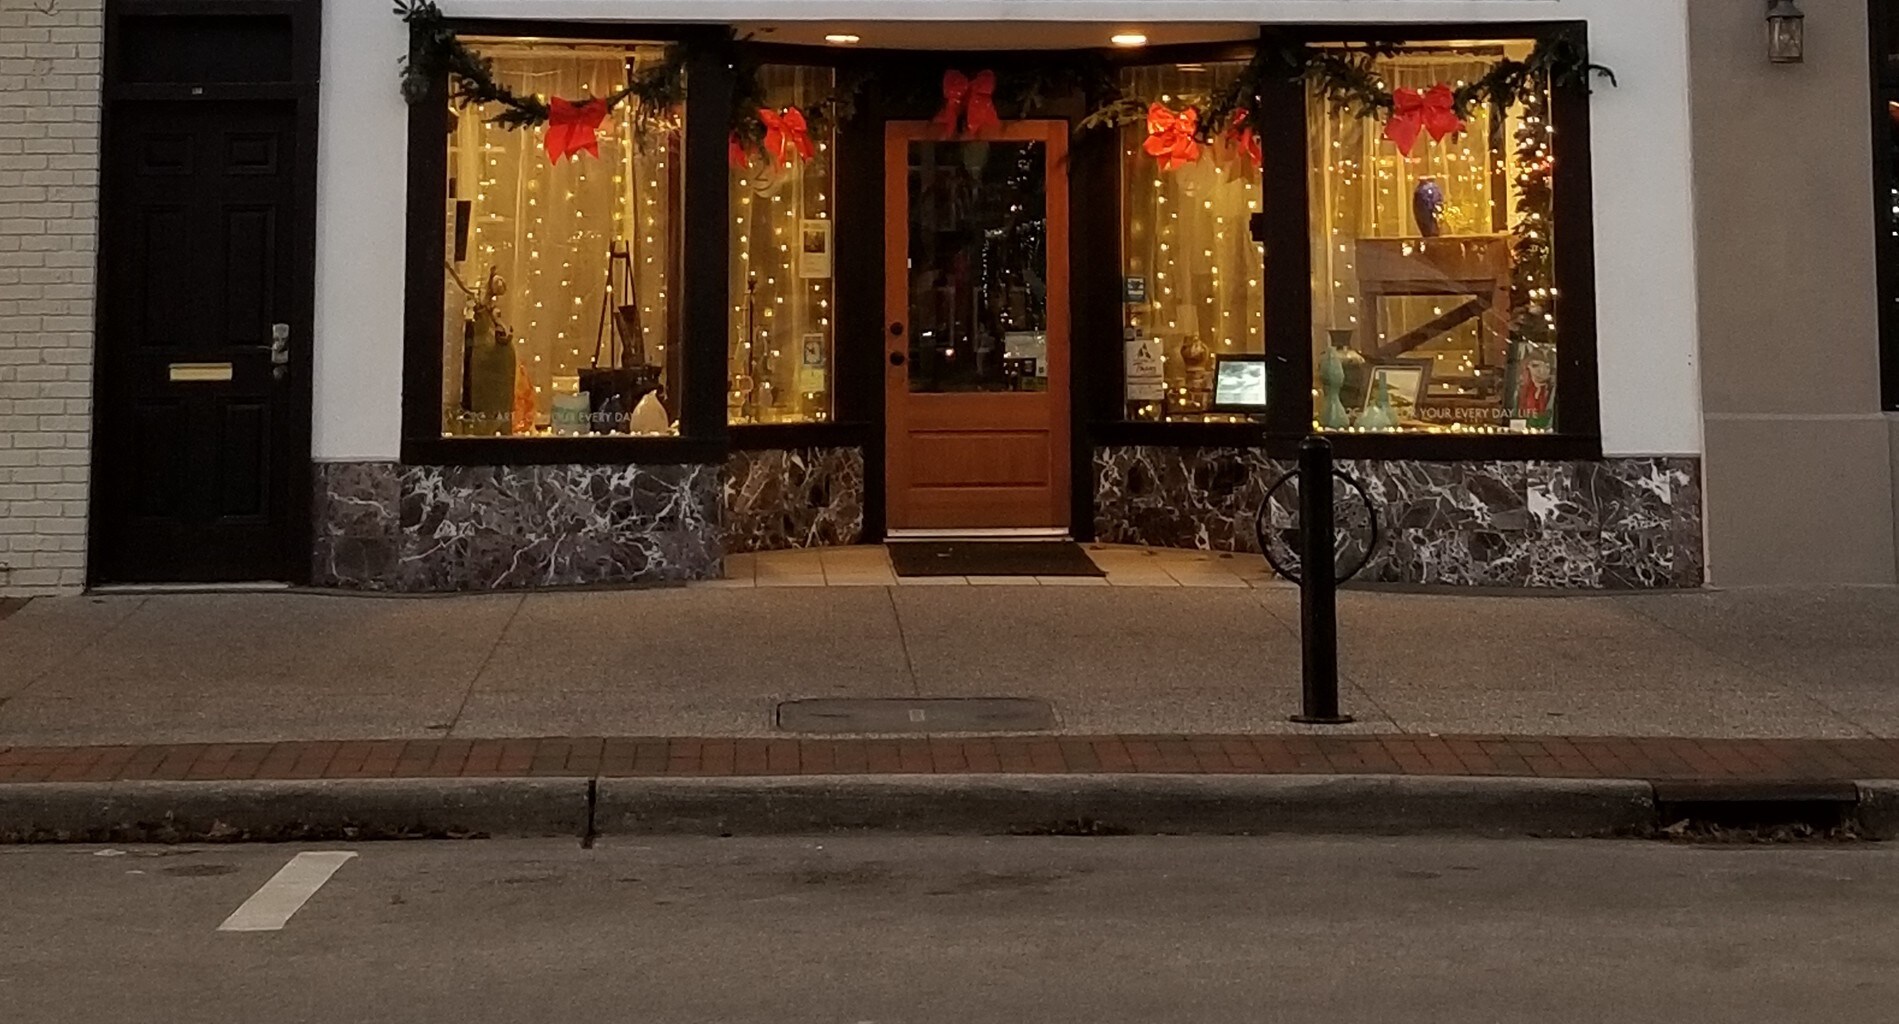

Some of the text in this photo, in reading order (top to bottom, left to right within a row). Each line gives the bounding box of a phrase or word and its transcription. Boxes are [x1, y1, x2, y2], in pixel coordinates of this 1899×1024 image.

[578, 411, 612, 423] EVERY
[1420, 407, 1451, 419] YOUR
[1455, 407, 1489, 419] EVERY
[1492, 407, 1514, 419] DAY
